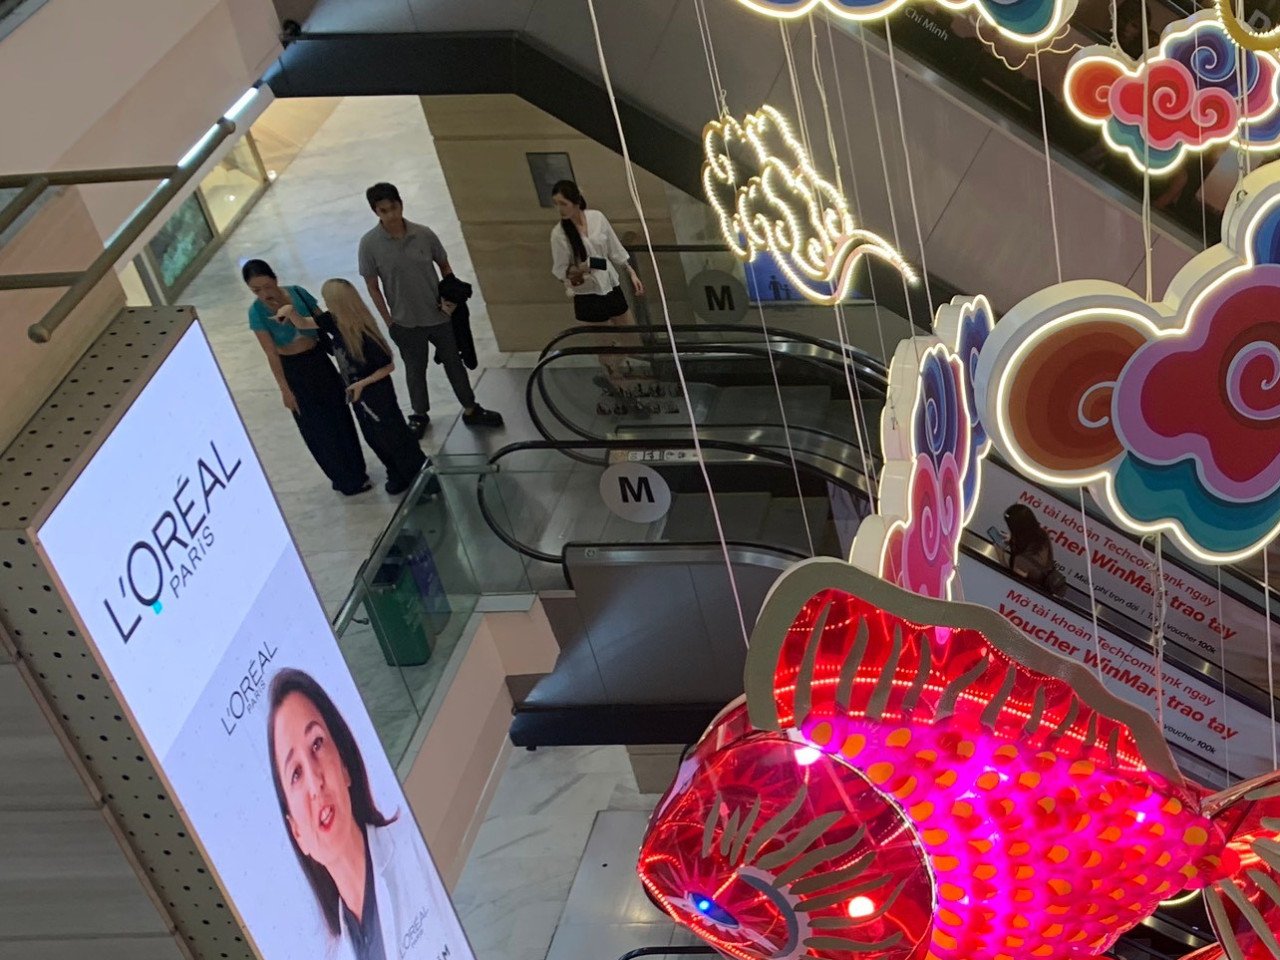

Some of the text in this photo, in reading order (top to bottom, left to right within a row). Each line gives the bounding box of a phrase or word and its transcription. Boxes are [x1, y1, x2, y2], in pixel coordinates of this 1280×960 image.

[921, 18, 949, 41] Minh
[705, 283, 736, 312] M
[618, 475, 656, 504] M
[103, 440, 242, 644] L'ORÉAL
[170, 525, 214, 599] PARIS
[1043, 504, 1061, 519] tài
[1185, 583, 1216, 607] ngay
[1167, 620, 1197, 644] voucher
[1197, 639, 1216, 654] 100k
[1169, 594, 1206, 623] trao
[1208, 614, 1237, 641] tay
[1006, 588, 1030, 608] Mở
[1031, 601, 1050, 618] tài
[1050, 610, 1093, 641] khoản
[1183, 684, 1216, 707] ngay
[221, 641, 278, 736] L'ORÉAL
[1164, 724, 1216, 755] voucher 100k
[1167, 694, 1204, 723] trao
[1207, 716, 1239, 741] tay
